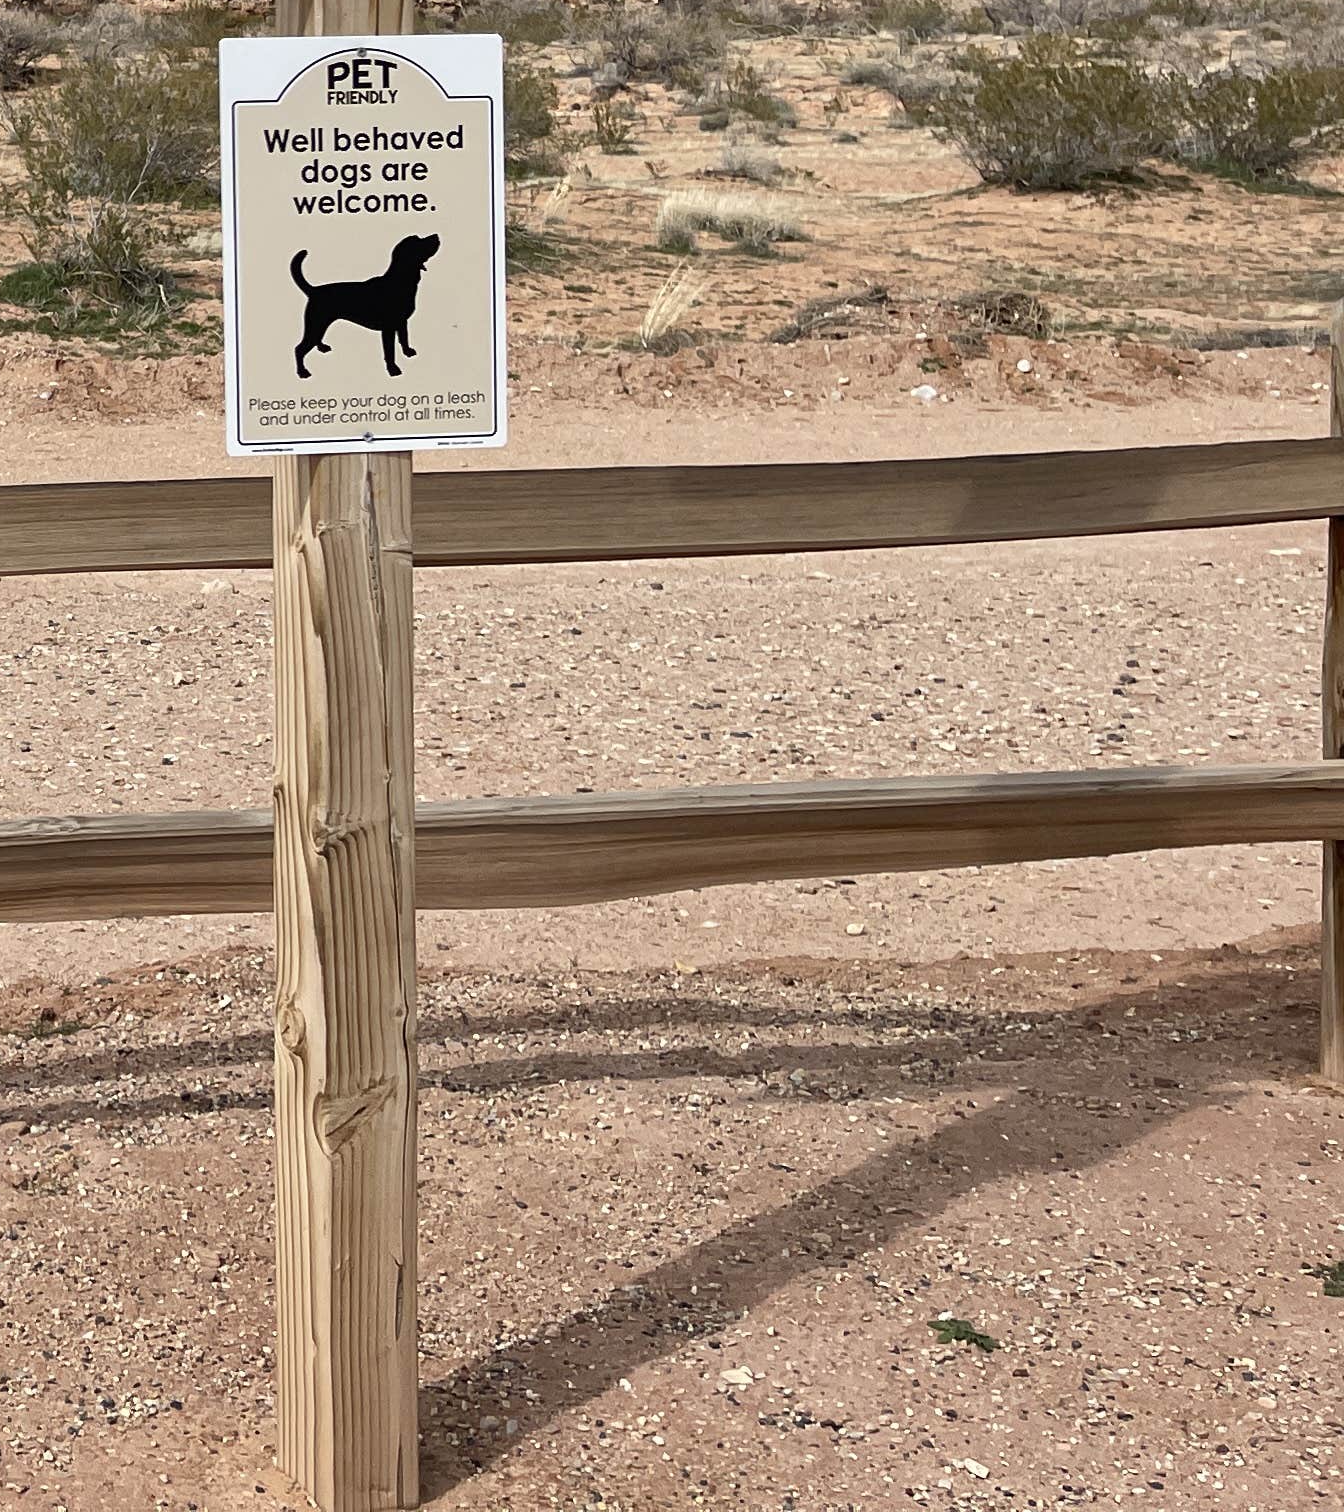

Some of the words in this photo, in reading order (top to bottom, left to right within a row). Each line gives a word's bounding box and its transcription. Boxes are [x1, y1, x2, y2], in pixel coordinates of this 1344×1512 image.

[326, 58, 398, 90] PET
[326, 89, 398, 105] FRIENDLY
[263, 127, 324, 153] Well
[333, 124, 464, 152] behaved
[300, 158, 372, 189] dogs
[381, 162, 429, 182] are
[293, 189, 437, 215] welcome.
[248, 397, 296, 411] Please
[300, 396, 338, 412] keep
[341, 396, 374, 411] your
[377, 394, 407, 409] dog
[410, 395, 430, 406] on
[434, 394, 444, 405] a
[447, 390, 486, 405] leash
[259, 413, 289, 426] and
[293, 412, 337, 425] under
[339, 408, 391, 424] control
[394, 409, 410, 422] at
[414, 407, 430, 421] all
[434, 406, 476, 420] times.
